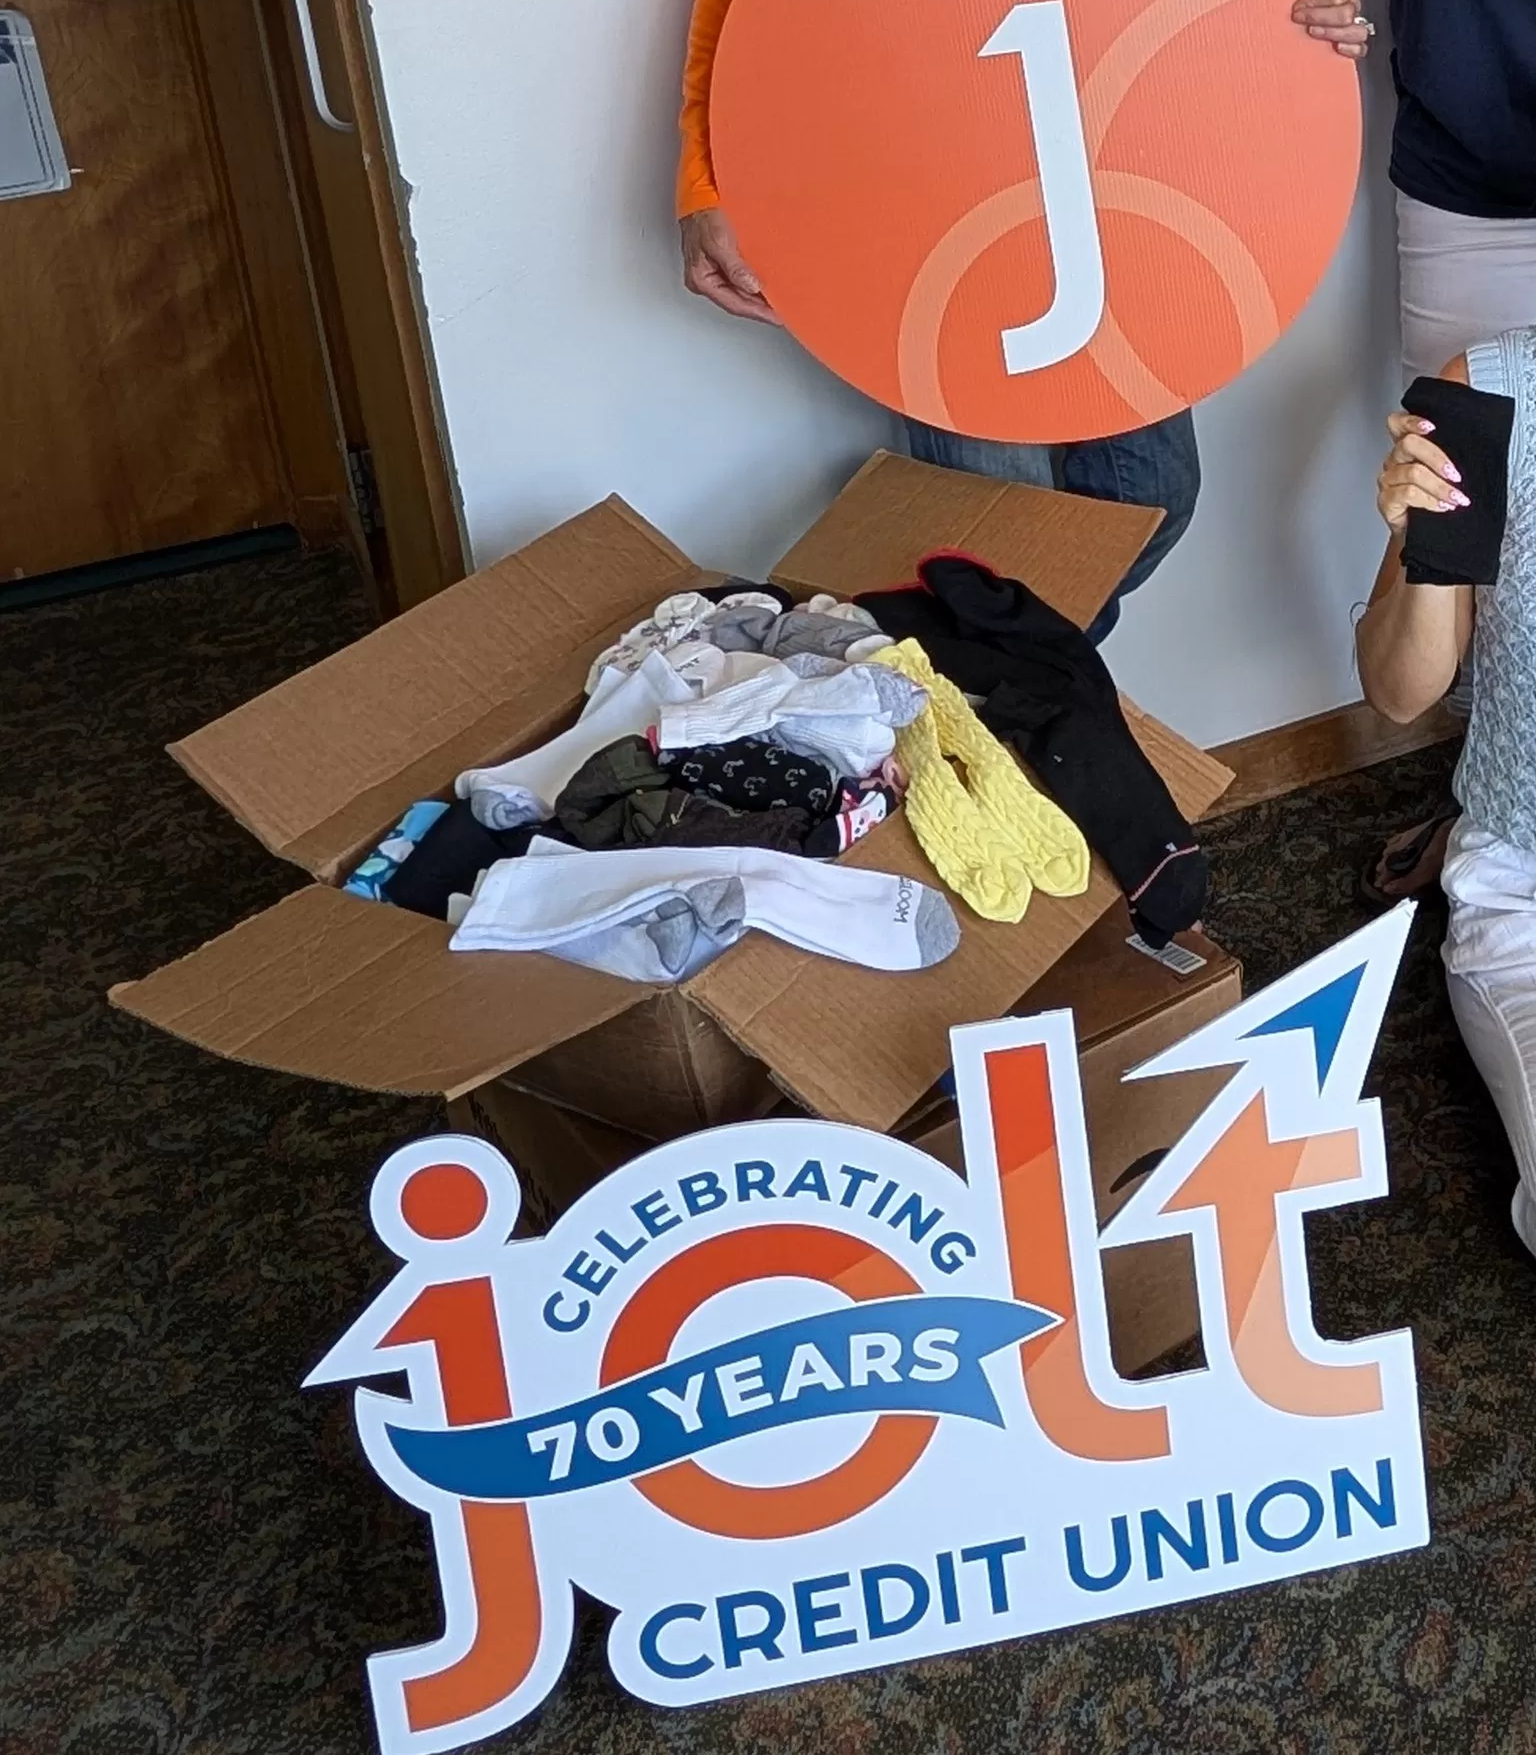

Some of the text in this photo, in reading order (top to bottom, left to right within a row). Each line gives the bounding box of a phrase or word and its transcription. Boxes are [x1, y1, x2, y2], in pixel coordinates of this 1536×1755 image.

[540, 1157, 978, 1335] CELEBRATING
[375, 1042, 1384, 1734] jolt
[526, 1325, 963, 1482] 70 YEARS
[638, 1457, 1399, 1680] CREDIT UNION
